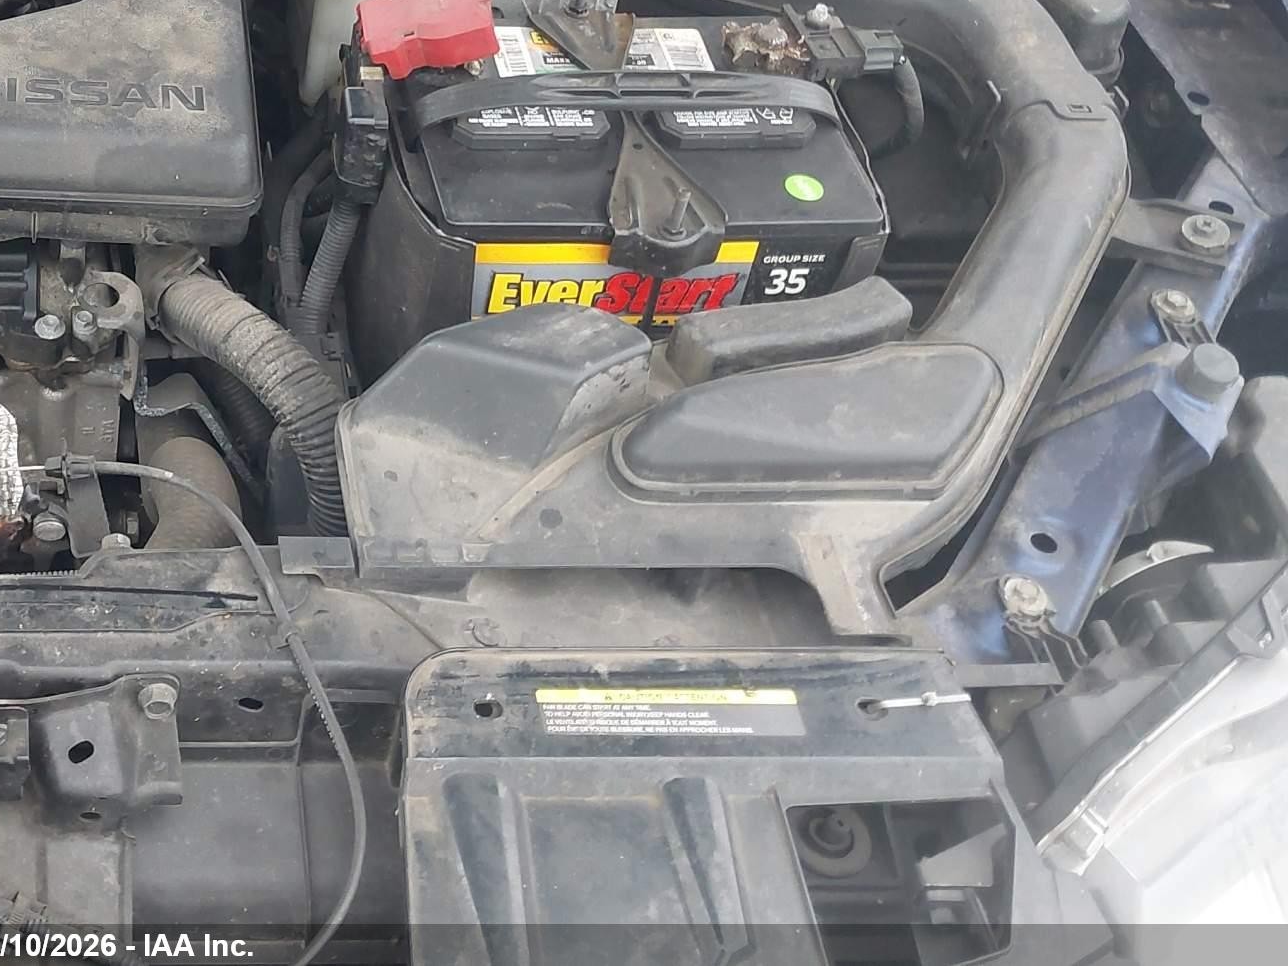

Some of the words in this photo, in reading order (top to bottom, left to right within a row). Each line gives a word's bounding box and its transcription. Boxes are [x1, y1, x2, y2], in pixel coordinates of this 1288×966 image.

[763, 254, 801, 264] GROUP
[802, 254, 826, 263] SIZE
[764, 268, 810, 295] 35
